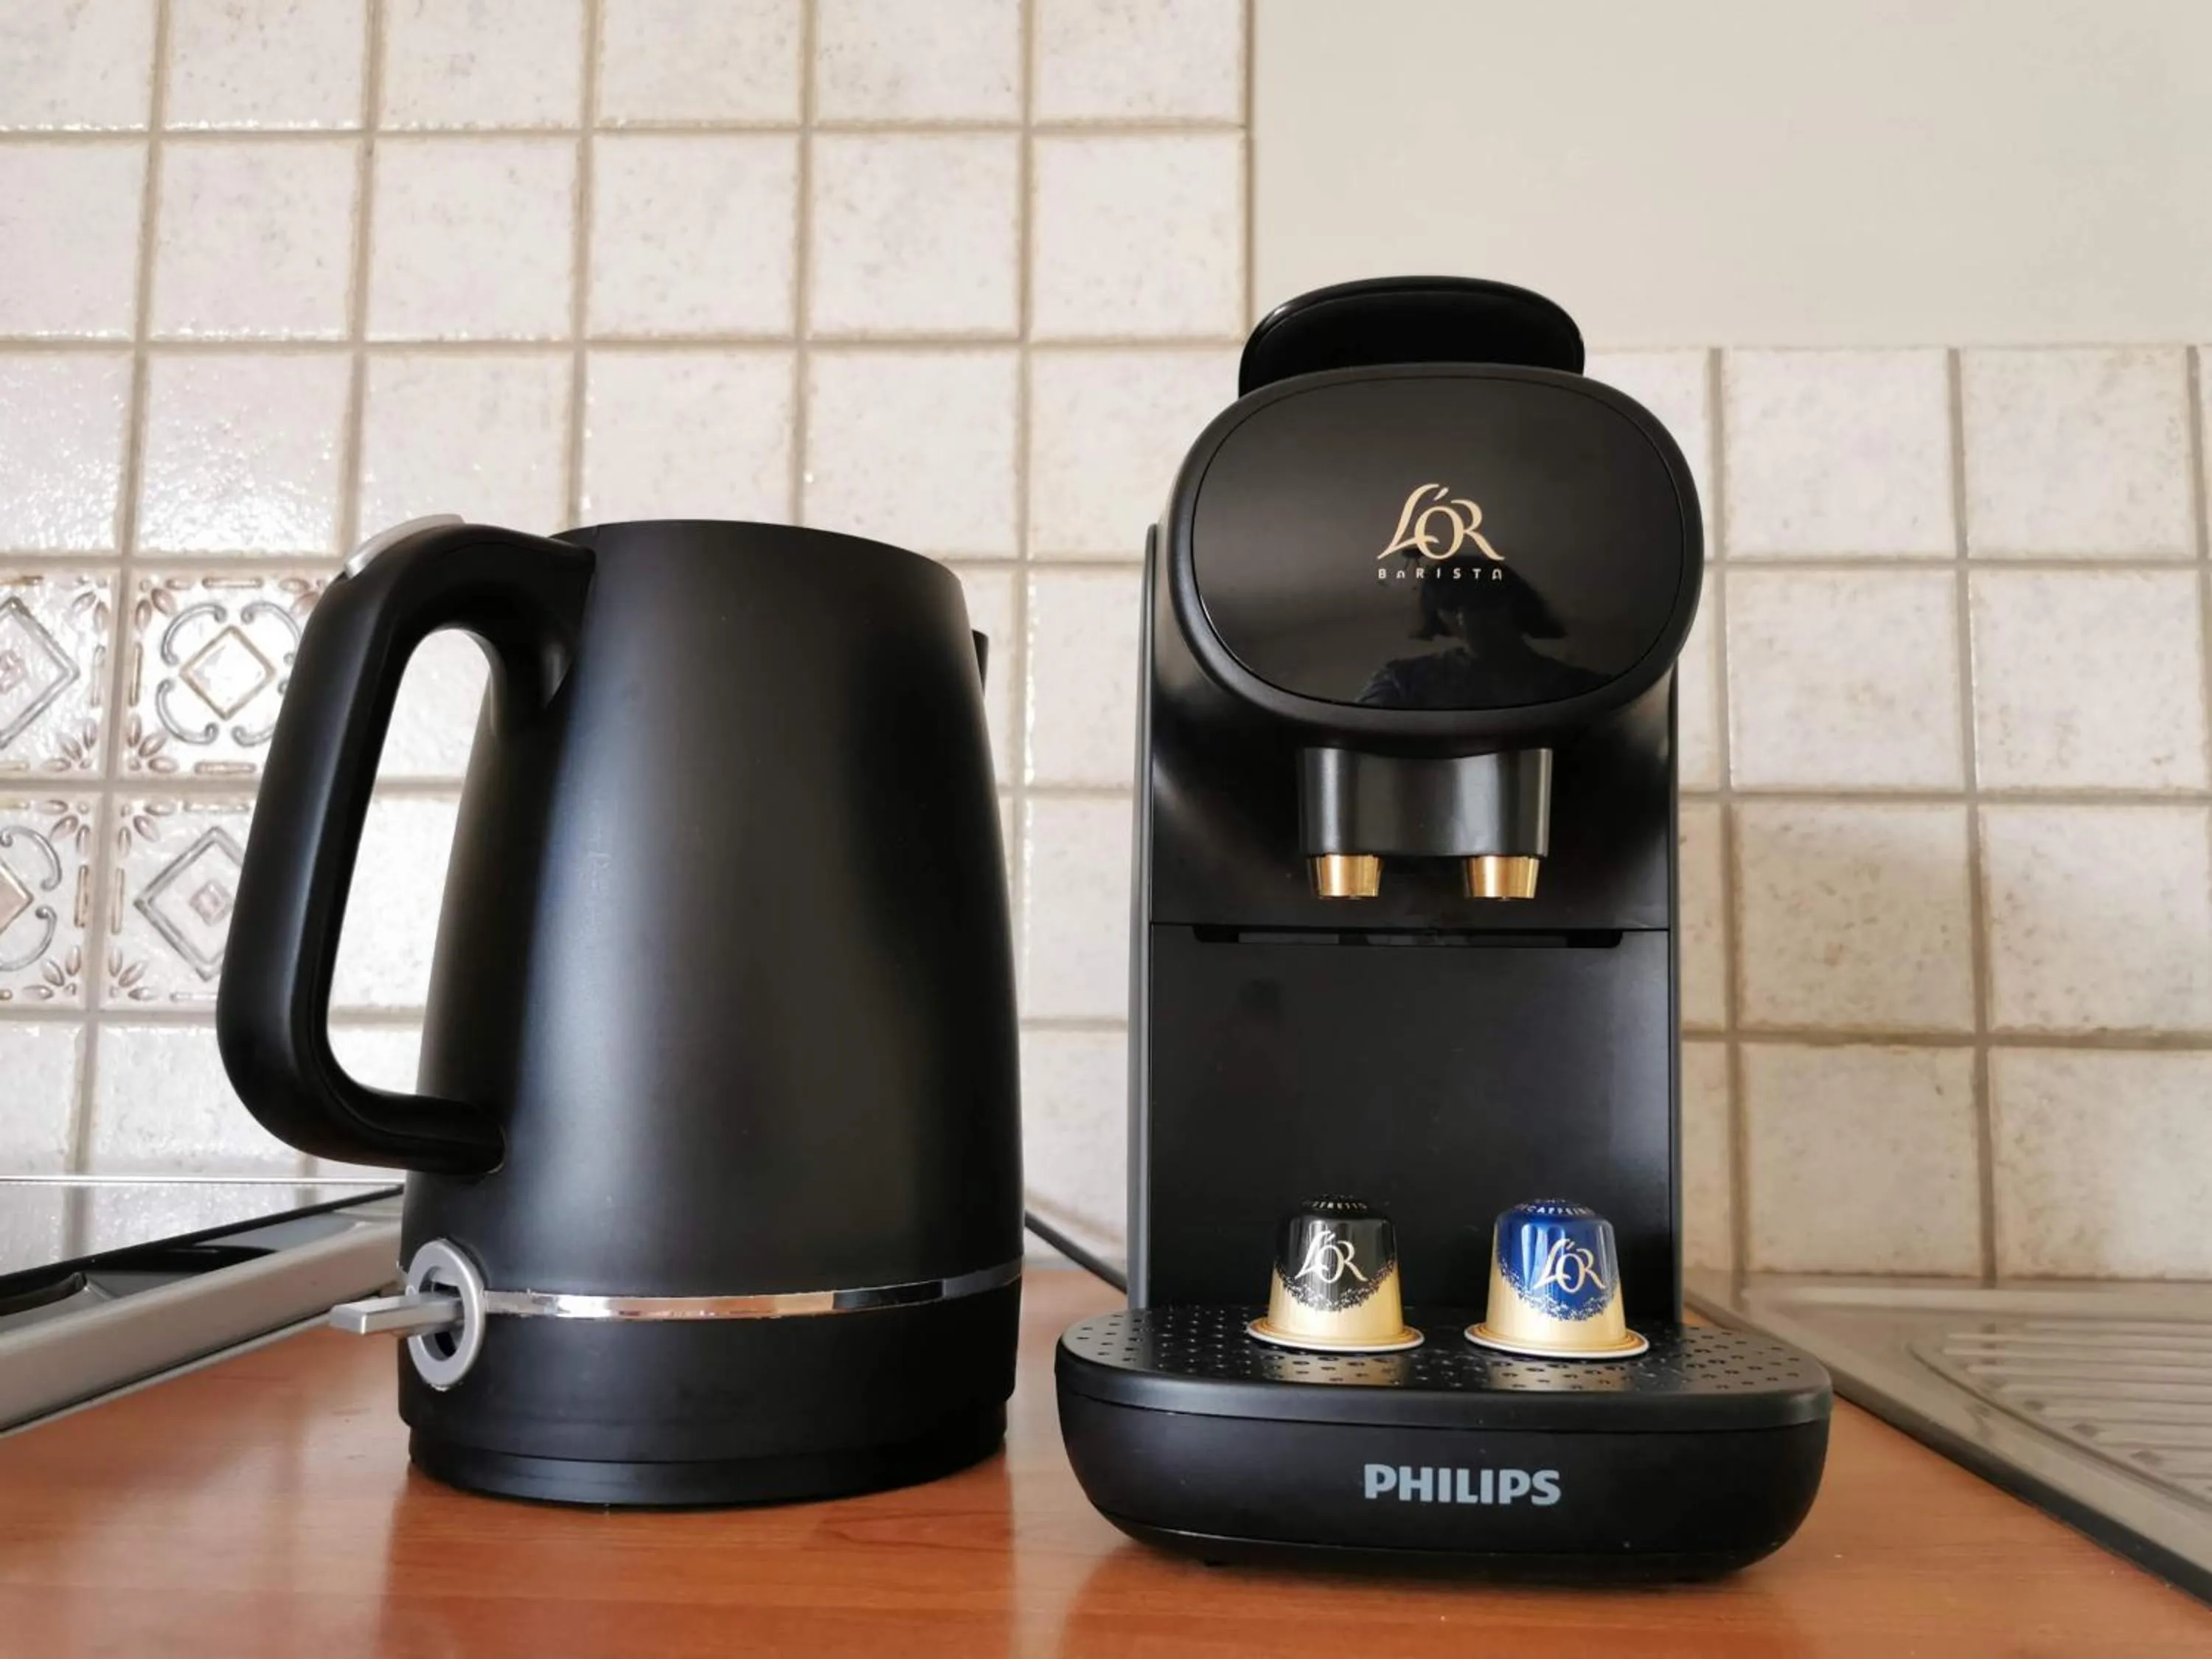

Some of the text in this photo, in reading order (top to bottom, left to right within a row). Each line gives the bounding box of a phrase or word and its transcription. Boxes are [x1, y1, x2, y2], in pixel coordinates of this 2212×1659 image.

[1377, 483, 1506, 560] L'OR
[1378, 568, 1503, 580] BARISTA
[1294, 1230, 1368, 1284] L'OR
[1533, 1237, 1607, 1294] L'OR
[1364, 1464, 1562, 1506] PHILIPS
